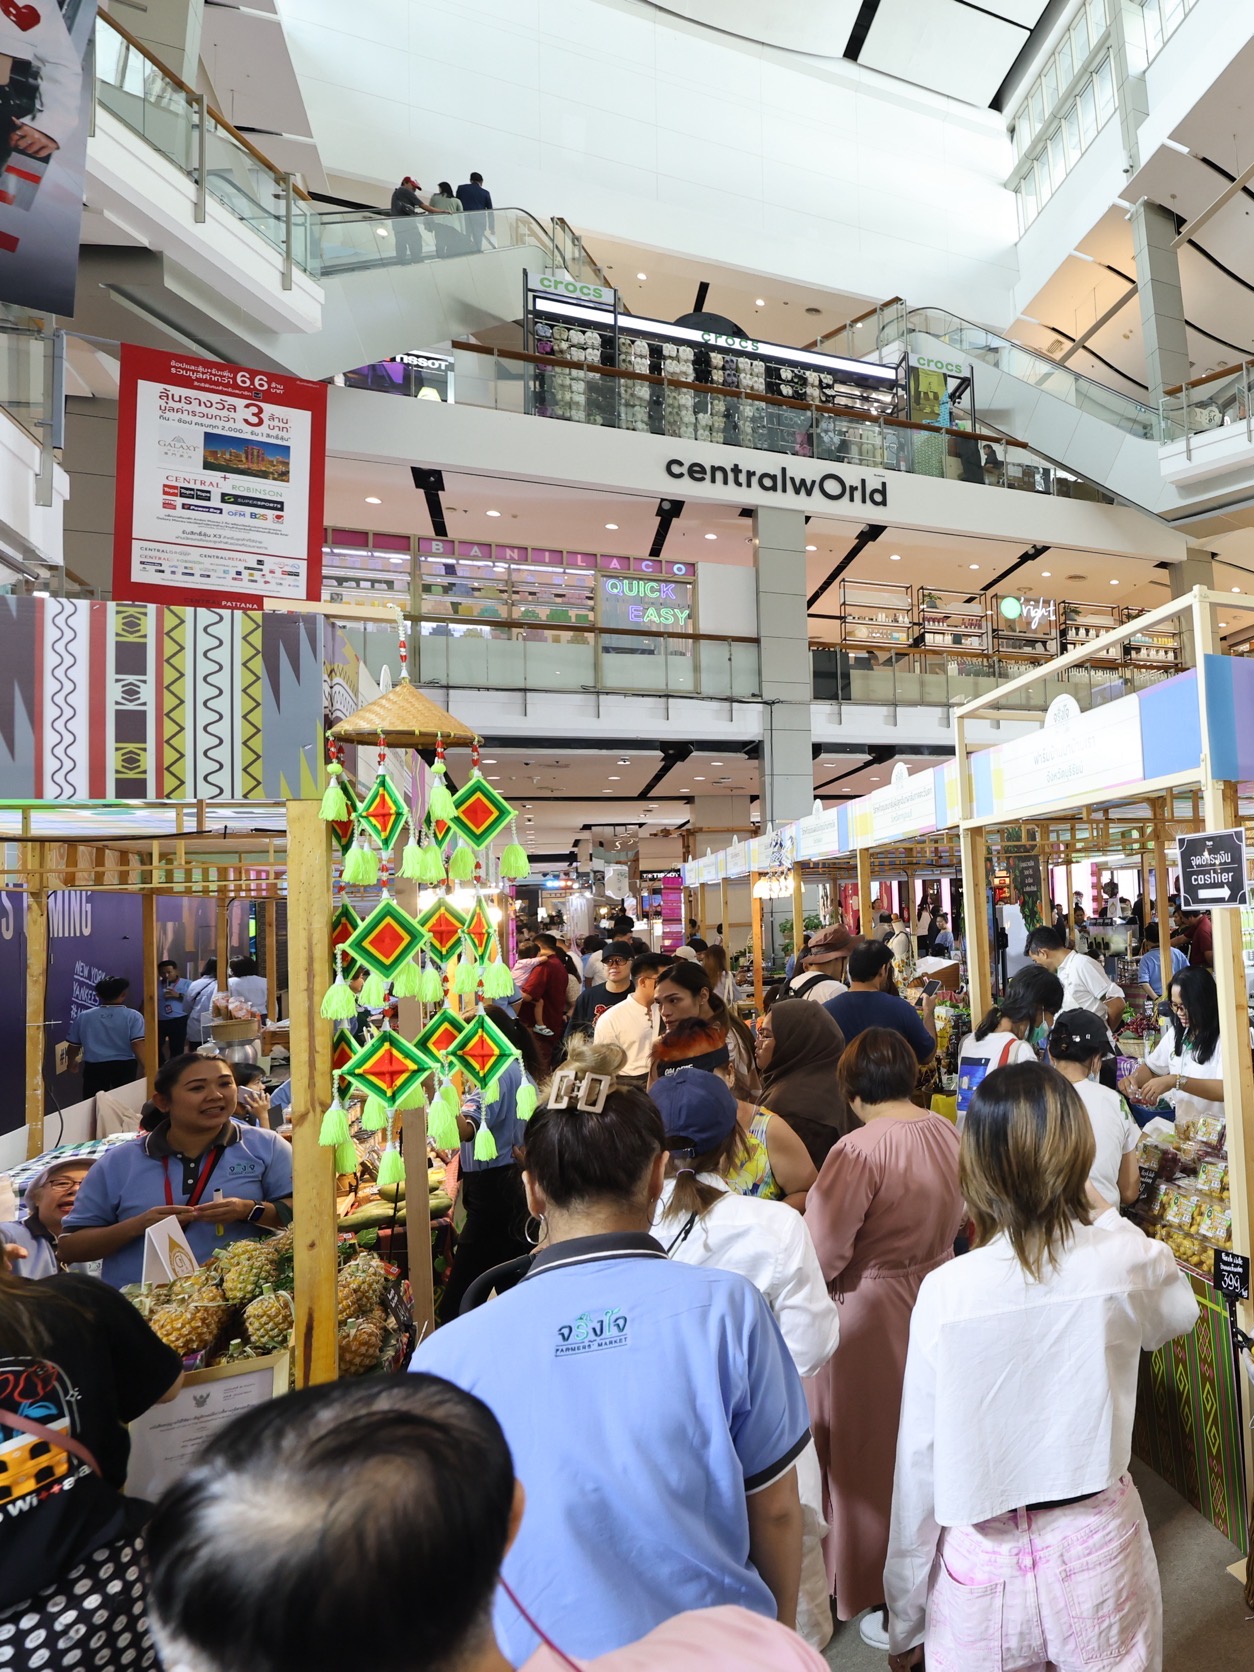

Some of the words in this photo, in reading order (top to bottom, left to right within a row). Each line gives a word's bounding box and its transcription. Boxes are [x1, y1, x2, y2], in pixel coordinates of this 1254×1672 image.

[539, 276, 603, 299] crocs
[701, 330, 761, 352] crocs
[917, 354, 963, 375] crocs
[236, 371, 269, 391] 6.6
[158, 388, 237, 413] ลุ้นรางวัล
[243, 403, 265, 428] 3
[268, 413, 289, 425] ล้าน
[159, 403, 236, 424] มูลค่ารวมกว่า
[158, 439, 199, 452] GALAXY
[166, 474, 222, 489] CENTRAL
[232, 484, 283, 498] ROBINSON
[666, 458, 888, 507] centralwOrld
[238, 497, 282, 509] SUPERSPORTS
[228, 510, 246, 519] OFM
[250, 511, 269, 521] B2S
[605, 579, 677, 599] QUICK
[222, 601, 259, 609] PATTANA
[629, 605, 690, 626] EASY
[1191, 870, 1234, 885] cashier
[75, 959, 89, 977] NEW
[597, 1337, 628, 1348] MARKET
